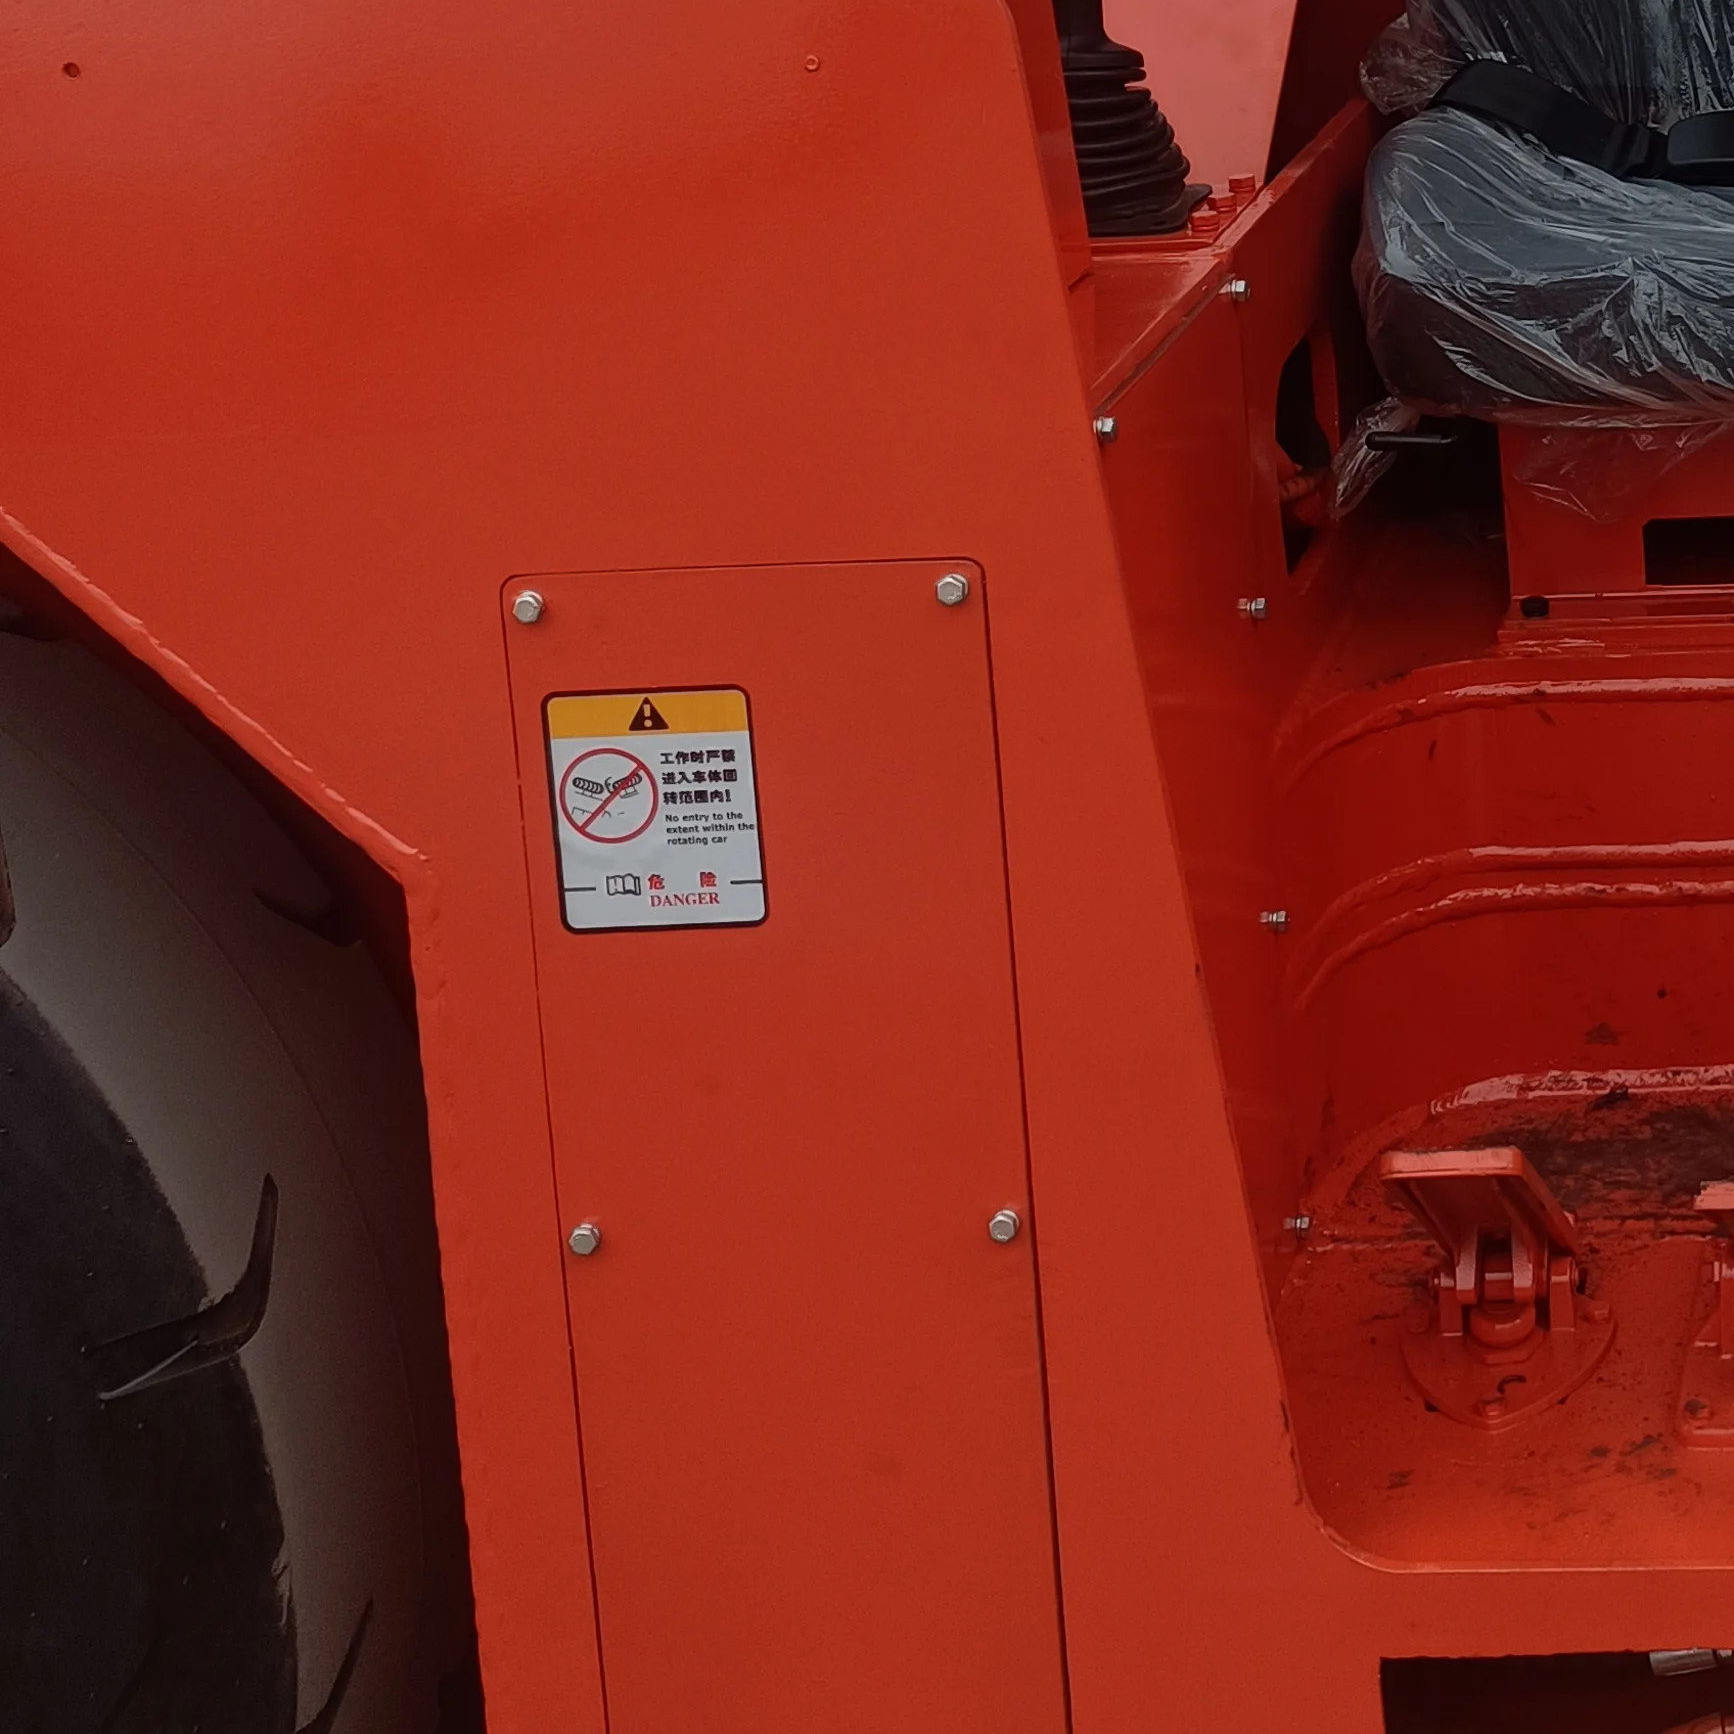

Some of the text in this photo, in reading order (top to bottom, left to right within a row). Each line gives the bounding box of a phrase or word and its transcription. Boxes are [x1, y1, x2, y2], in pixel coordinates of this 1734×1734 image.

[661, 769, 737, 785] 进入车体回
[665, 811, 743, 822] No entry to the
[666, 822, 755, 834] extent within the
[667, 836, 728, 846] rotating car
[650, 892, 720, 908] DANGER
